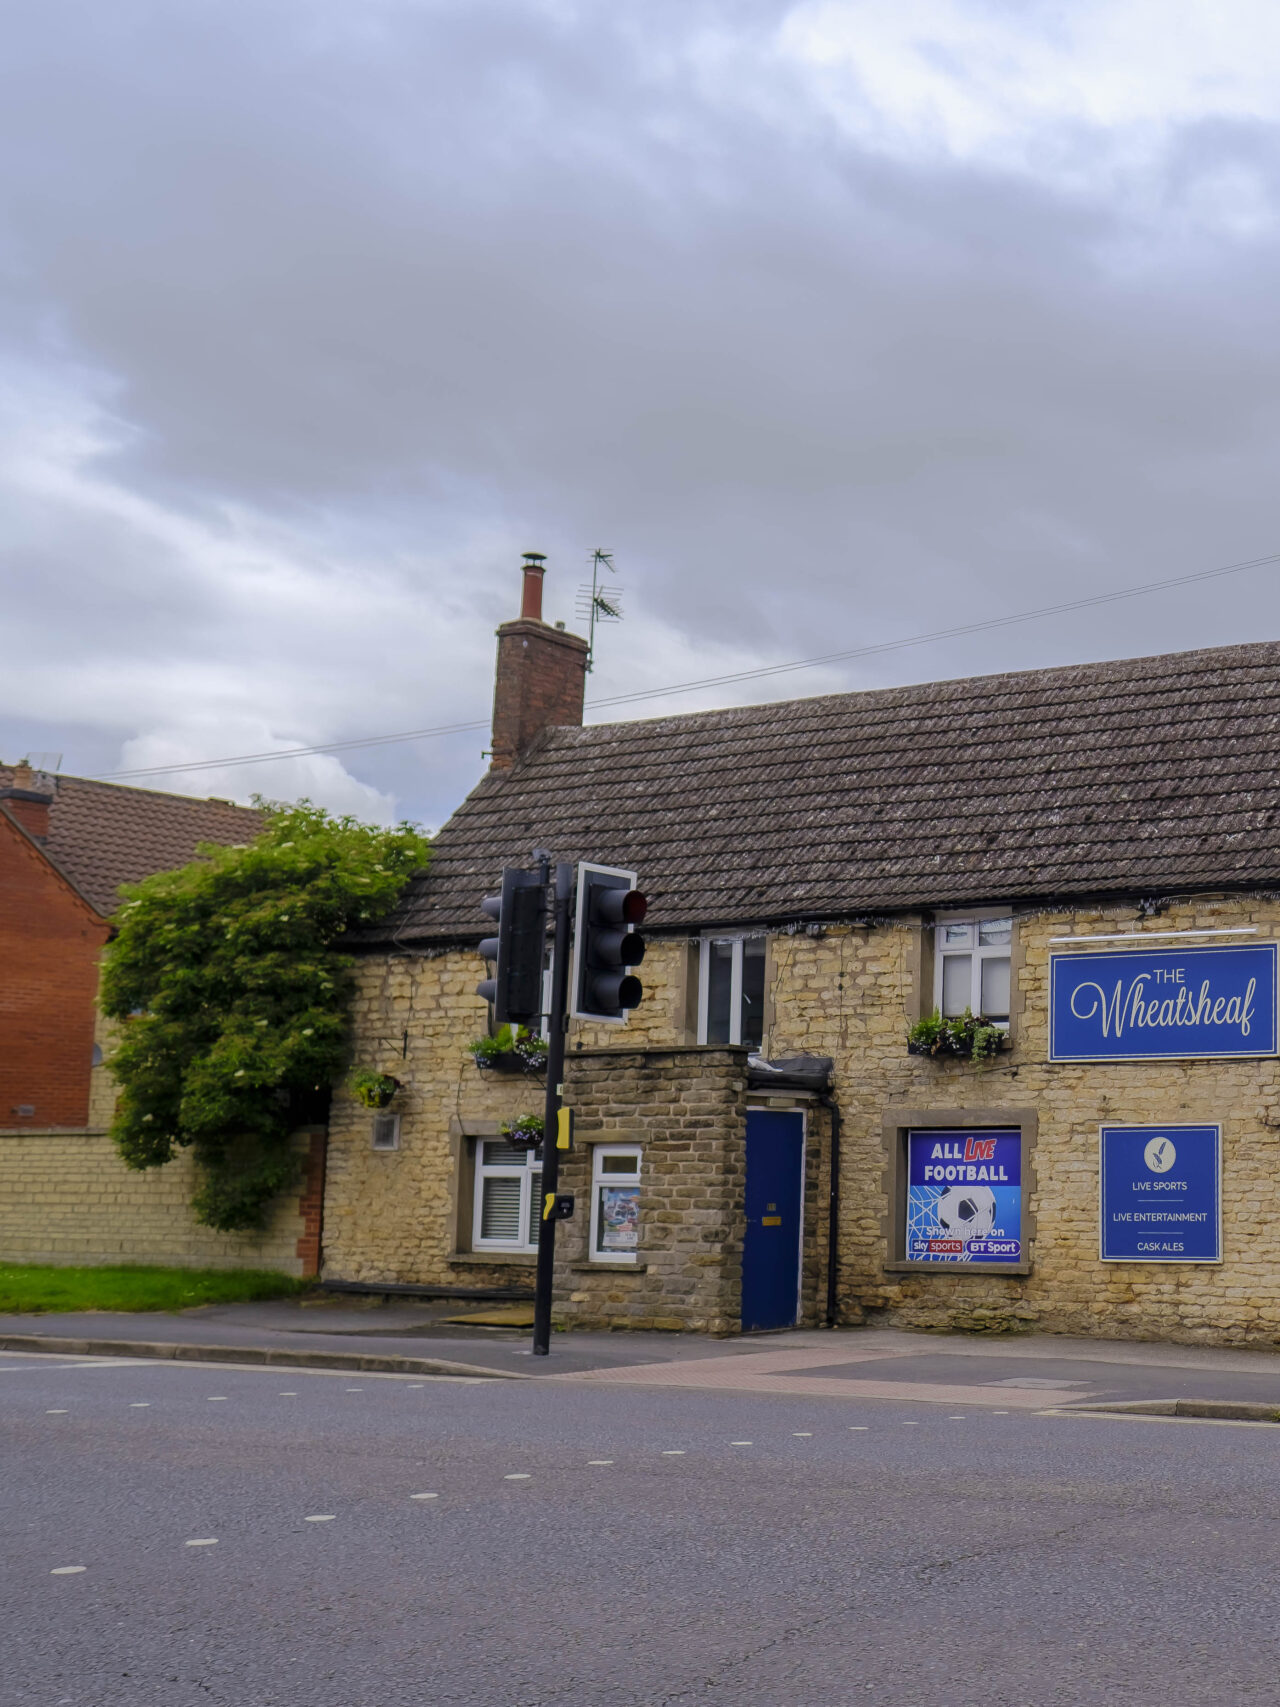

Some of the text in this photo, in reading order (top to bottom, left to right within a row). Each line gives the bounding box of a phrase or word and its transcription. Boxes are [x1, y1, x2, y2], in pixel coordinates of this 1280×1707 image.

[1153, 968, 1186, 984] THE
[1070, 973, 1257, 1038] Wheatsheaf
[930, 1137, 998, 1162] ALL LIVE
[924, 1165, 1009, 1181] FOOTBALL
[1132, 1181, 1188, 1191] LIVE SPORTS
[1113, 1212, 1208, 1222] LIVE ENTERTAINMENT
[926, 1227, 1005, 1237] Shown here on
[913, 1241, 961, 1252] sky sports
[970, 1241, 1016, 1253] BT Sport
[1137, 1242, 1184, 1252] CASK ALES
